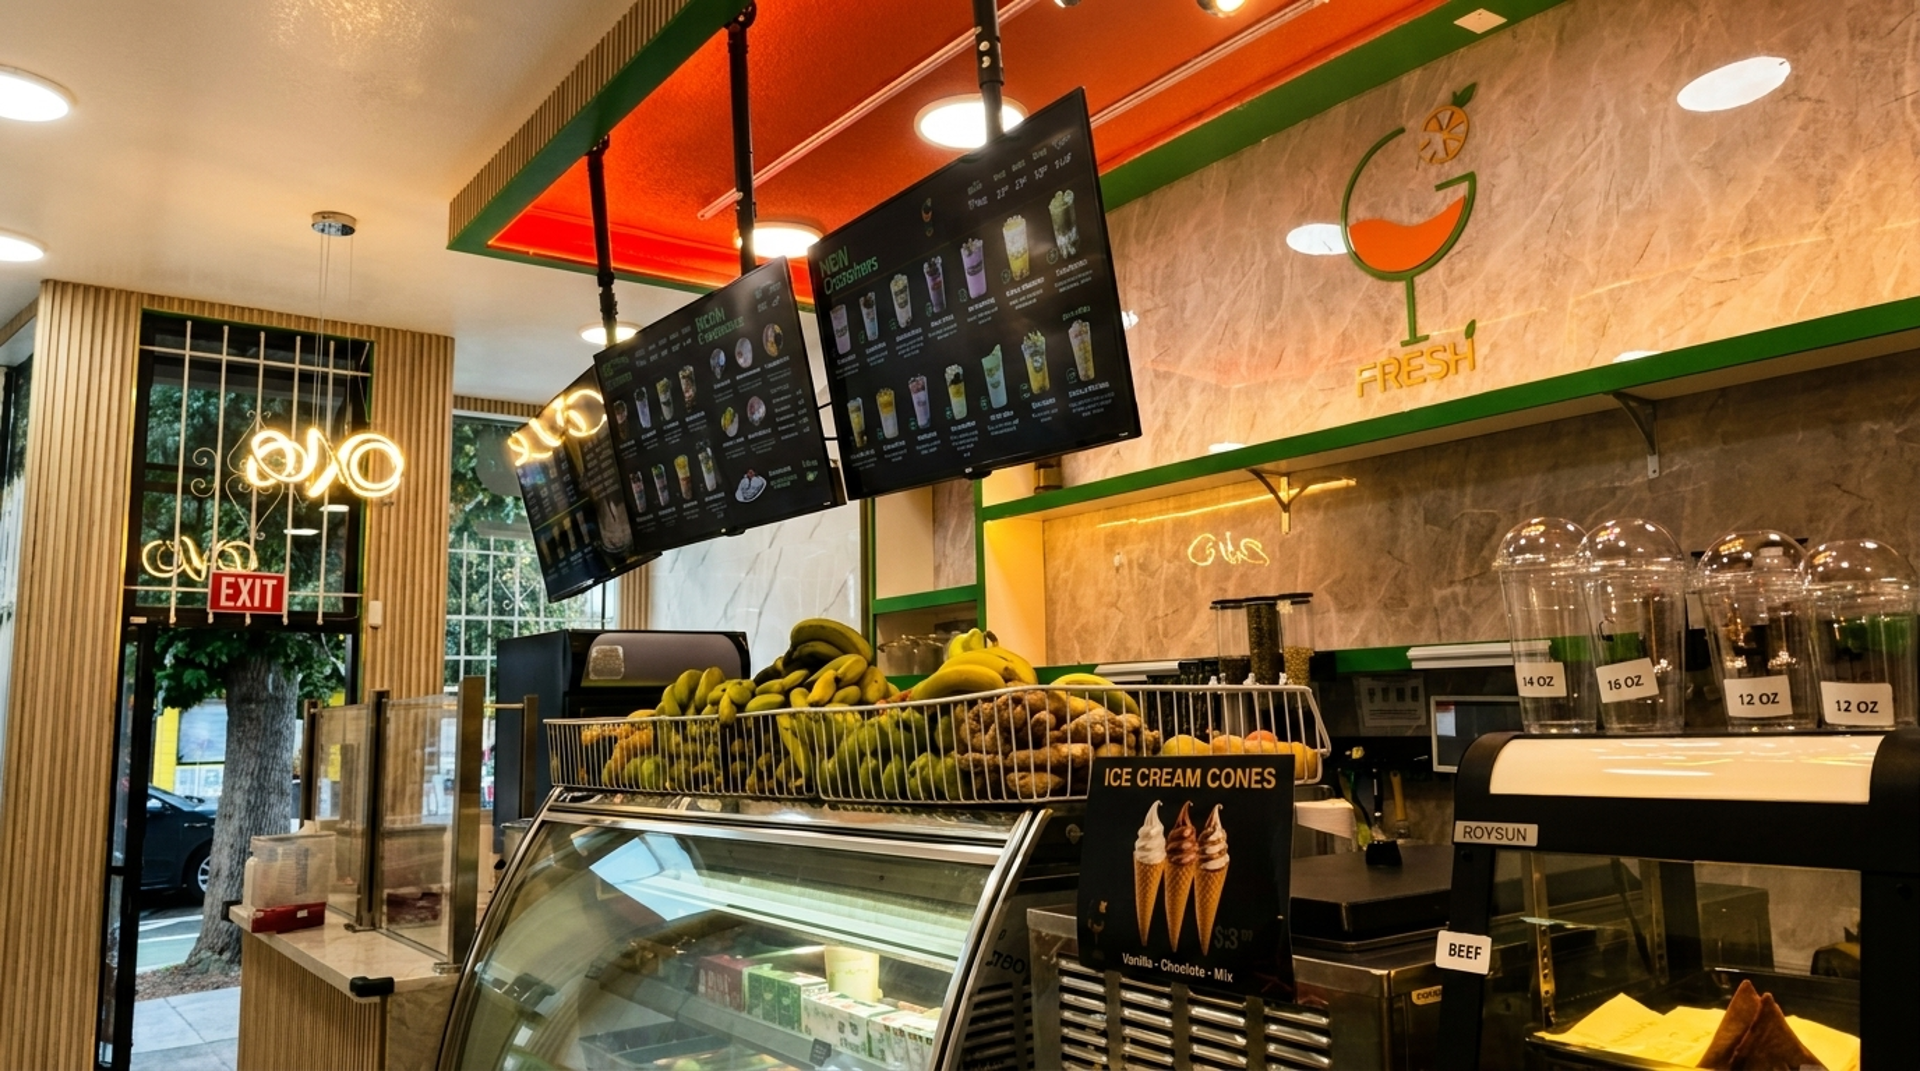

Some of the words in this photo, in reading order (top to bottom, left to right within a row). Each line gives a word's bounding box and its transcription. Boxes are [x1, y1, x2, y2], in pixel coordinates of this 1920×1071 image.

[1356, 336, 1476, 398] FRESH
[220, 576, 278, 608] EXIT
[1523, 676, 1534, 687] 14
[1537, 676, 1555, 687] OZ
[1608, 679, 1622, 691] 16
[1625, 675, 1644, 688] OZ
[1738, 694, 1755, 706] 12
[1759, 692, 1780, 705] OZ
[1835, 700, 1852, 712] 12
[1857, 701, 1879, 713] OZ
[1104, 767, 1132, 787] ICE
[1136, 767, 1201, 788] CREAM
[1206, 768, 1276, 789] CONES
[1463, 825, 1527, 842] ROYSUN
[1448, 943, 1482, 960] BEEF
[1122, 952, 1153, 968] Vanilla
[1214, 967, 1234, 983] Mix
